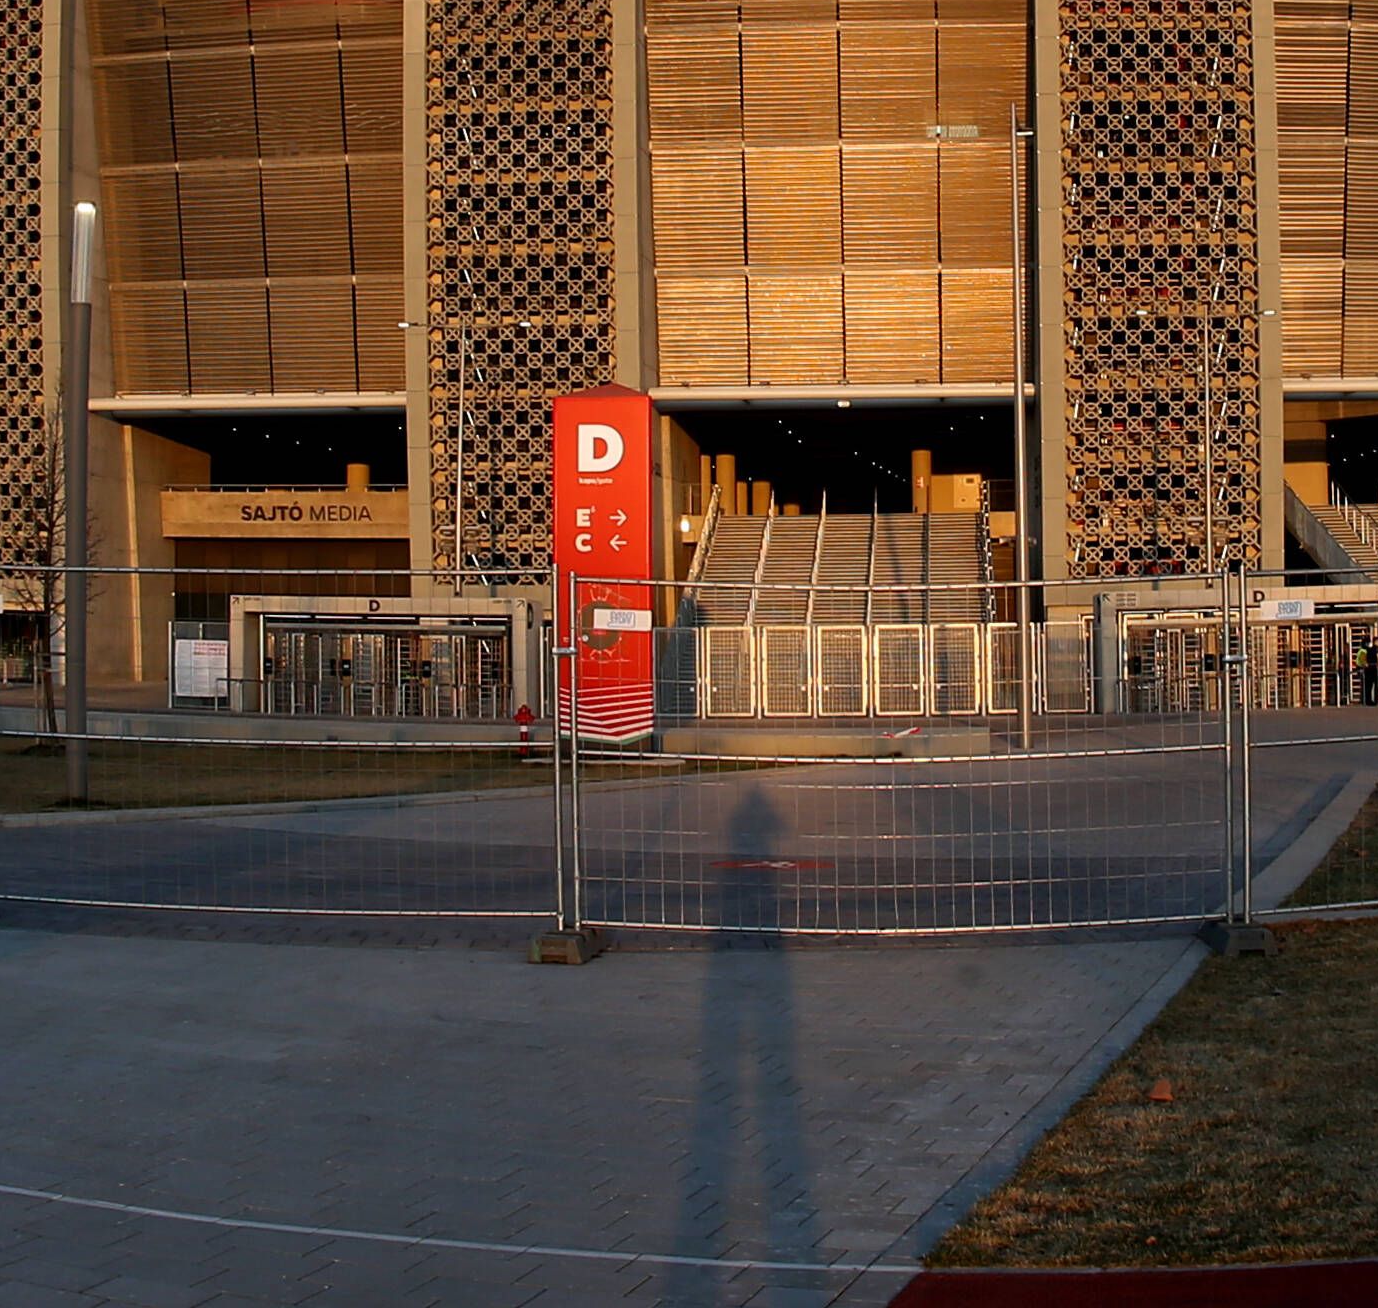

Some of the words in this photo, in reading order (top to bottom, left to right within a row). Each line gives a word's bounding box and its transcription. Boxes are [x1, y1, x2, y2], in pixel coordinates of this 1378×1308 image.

[577, 423, 625, 472] D
[241, 501, 303, 521] SAJTÓ
[310, 505, 372, 521] MEDIA
[576, 508, 591, 527] E
[575, 533, 592, 552] C
[369, 600, 381, 612] D
[1253, 590, 1265, 603] D
